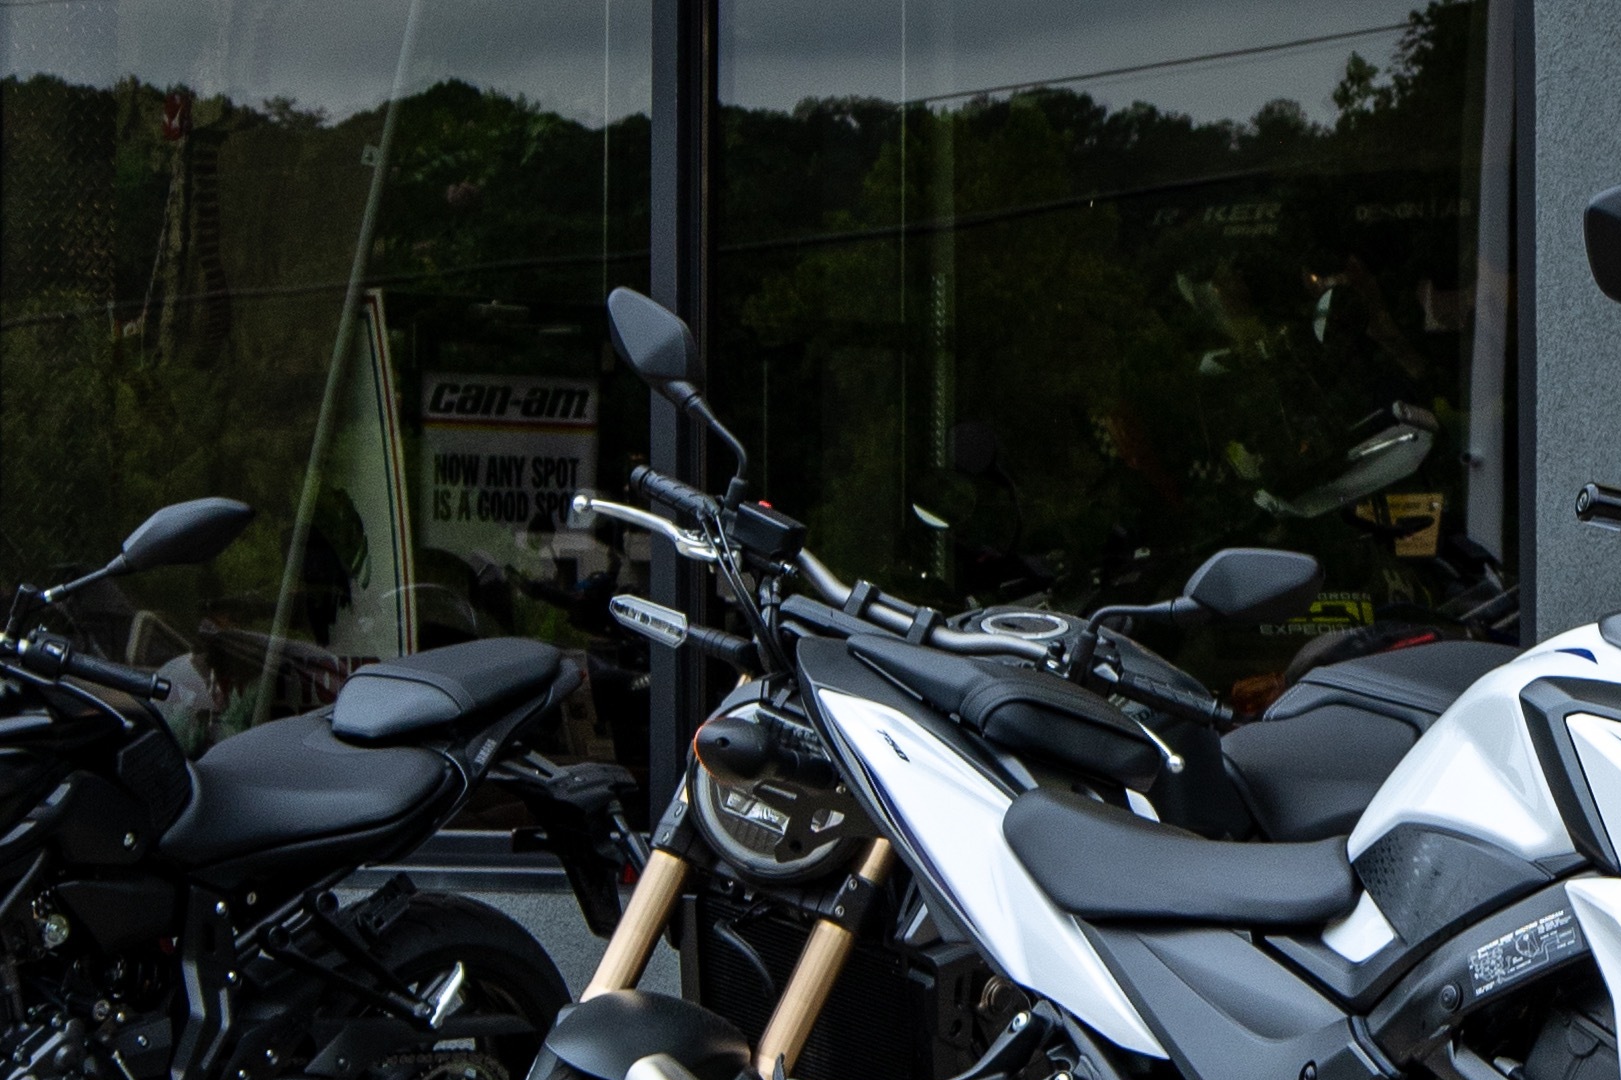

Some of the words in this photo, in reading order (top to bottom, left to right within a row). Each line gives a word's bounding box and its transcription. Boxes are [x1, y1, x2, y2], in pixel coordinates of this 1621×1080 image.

[428, 382, 589, 418] can-am
[434, 453, 479, 486] NOW
[486, 454, 526, 488] ANY
[531, 456, 579, 488] SPOT
[433, 488, 450, 521] IS
[457, 489, 471, 521] A
[477, 489, 529, 522] GOOD
[534, 492, 573, 523] SPO
